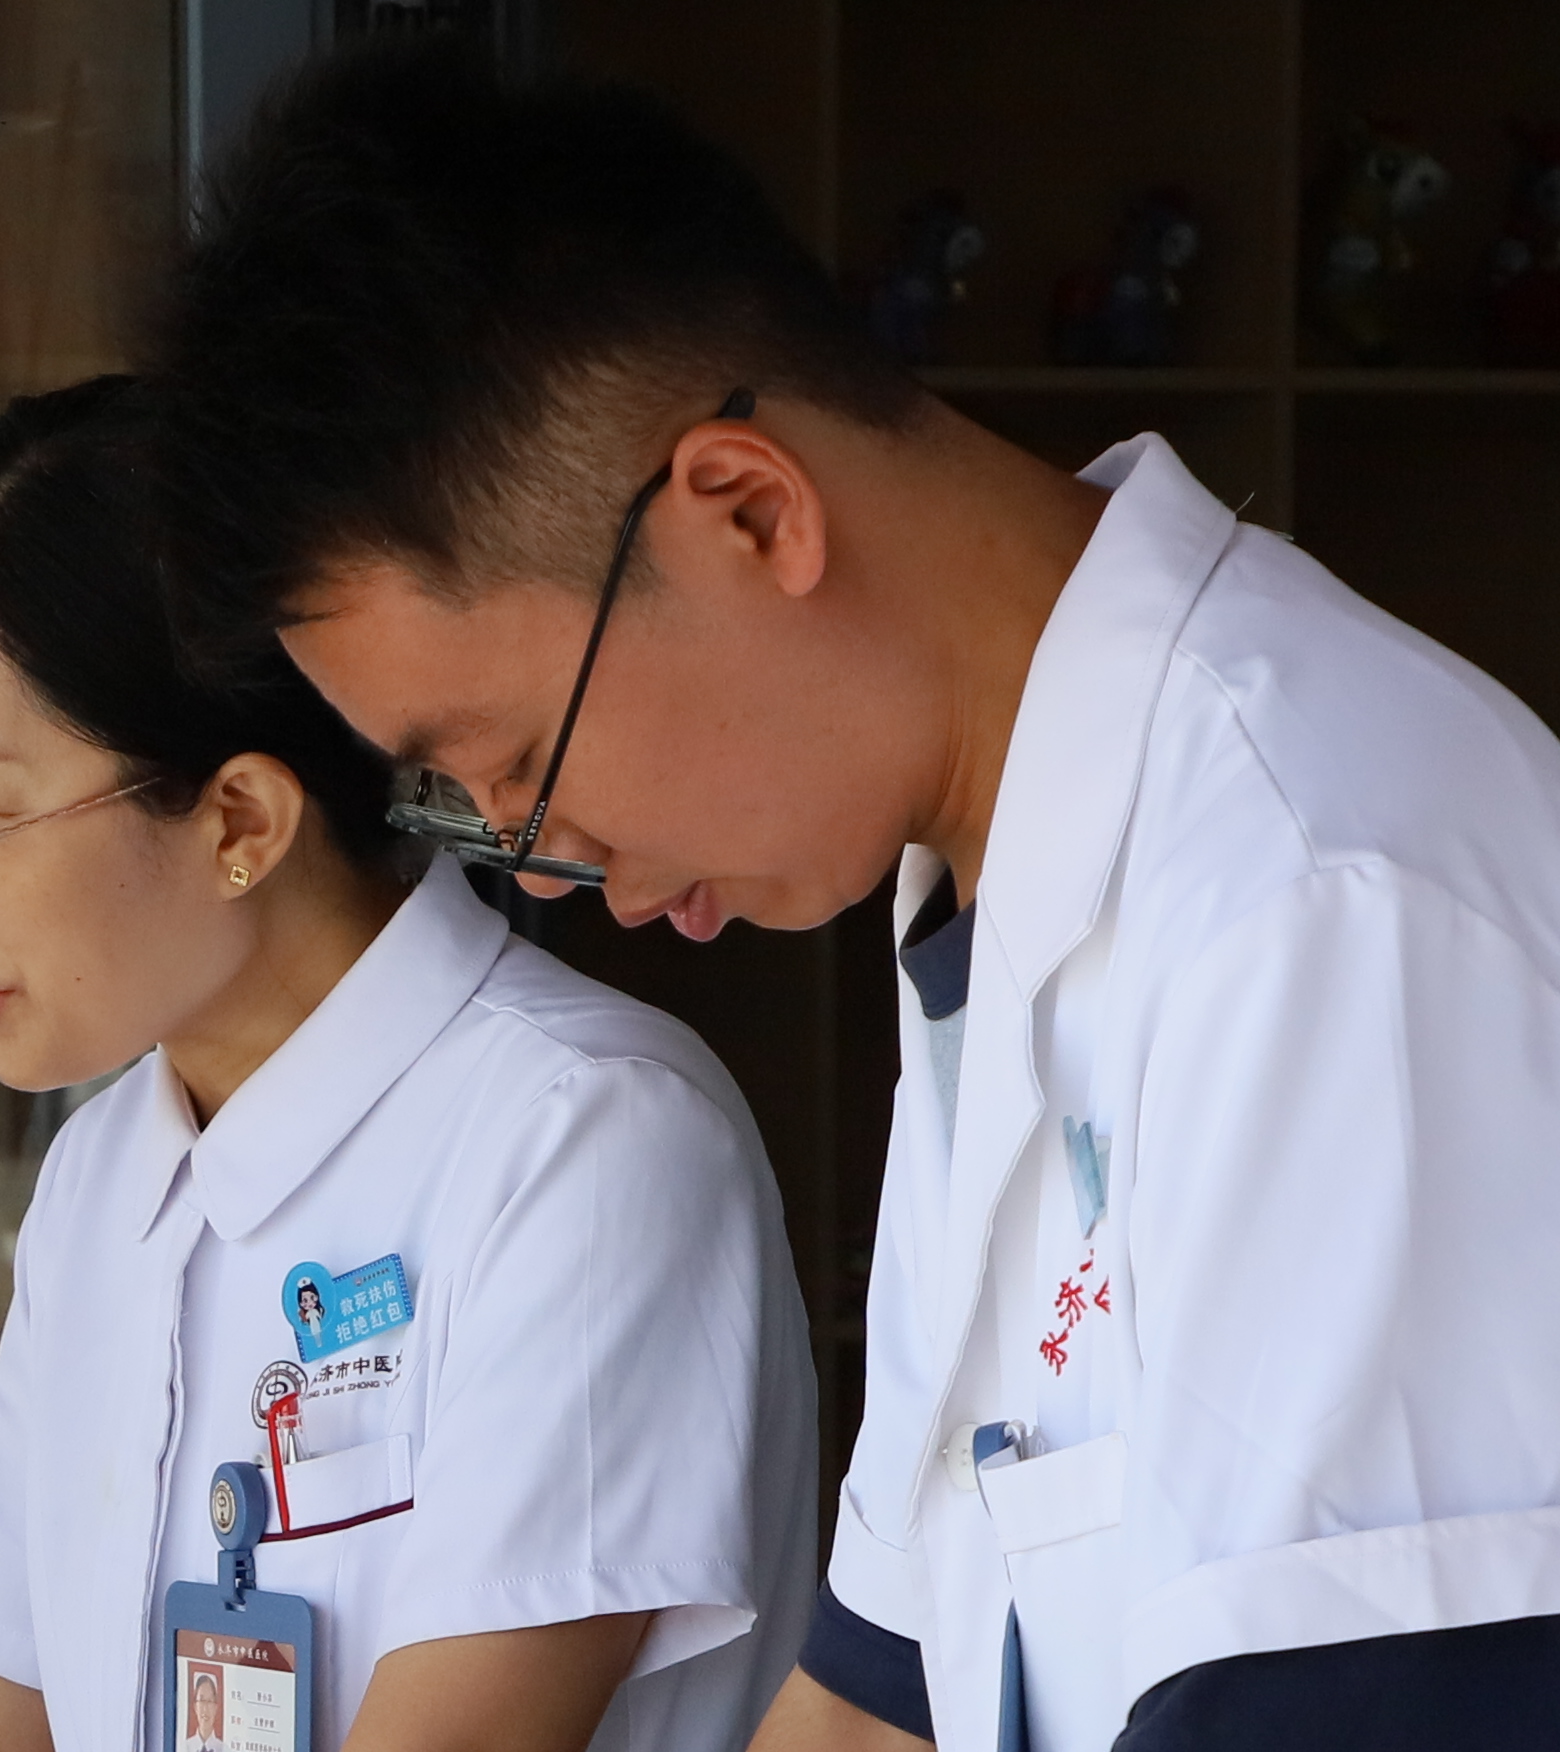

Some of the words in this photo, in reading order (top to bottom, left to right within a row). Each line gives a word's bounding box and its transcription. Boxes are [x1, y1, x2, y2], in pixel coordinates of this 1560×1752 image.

[340, 1280, 397, 1317] 救死扶伤
[335, 1302, 403, 1344] 拒绝红包
